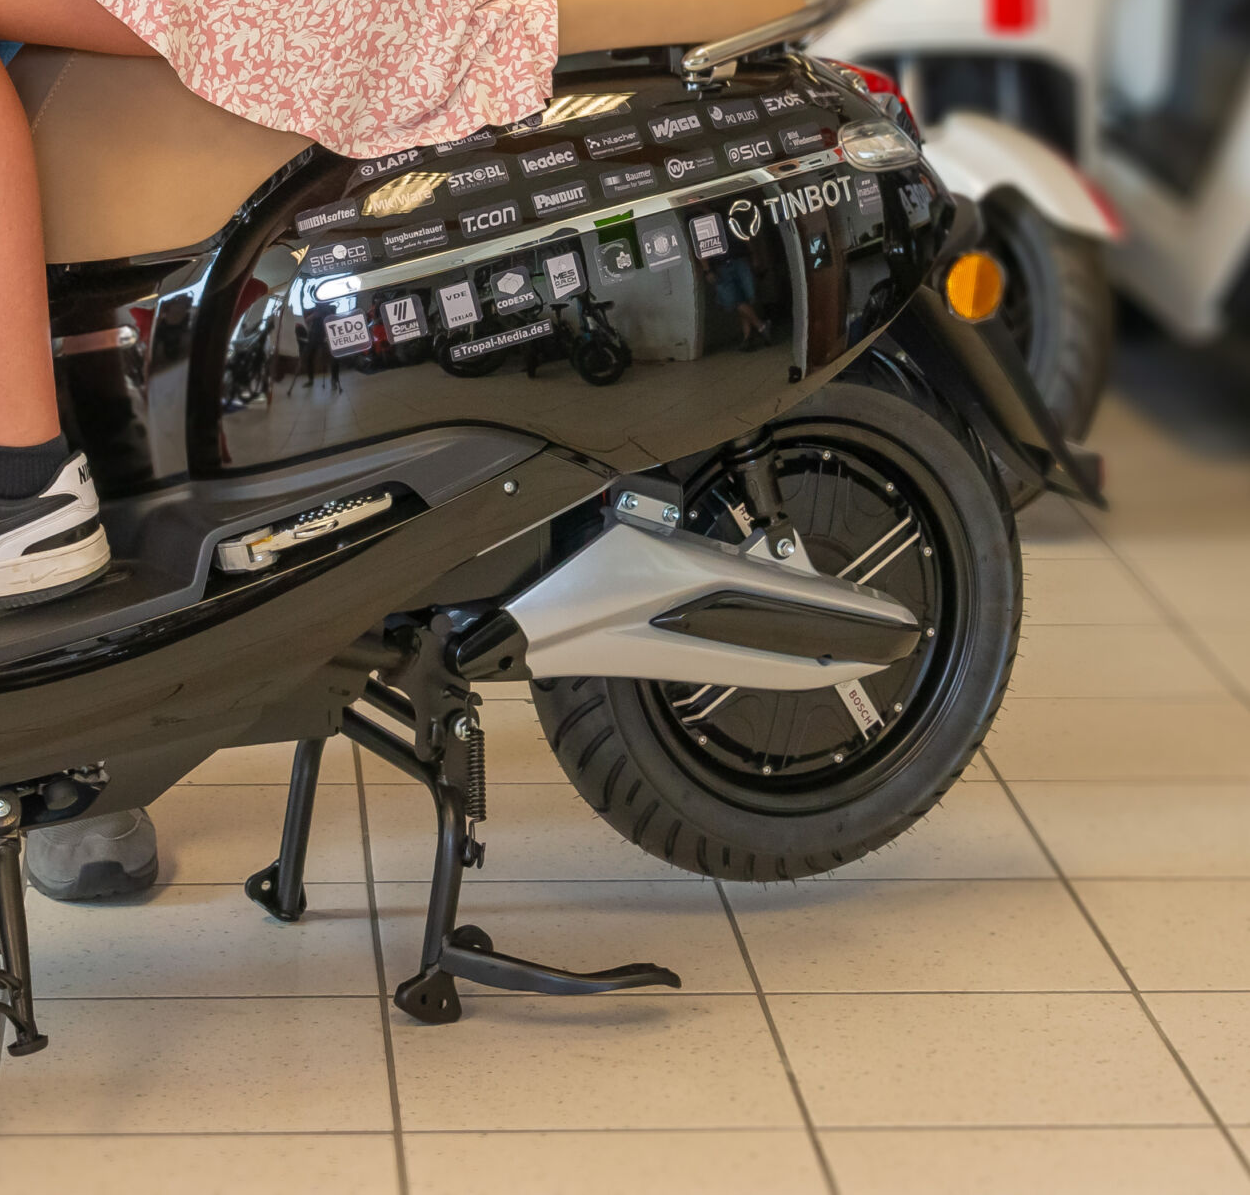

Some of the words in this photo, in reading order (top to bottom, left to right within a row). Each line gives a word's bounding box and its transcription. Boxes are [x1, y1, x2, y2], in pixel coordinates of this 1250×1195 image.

[652, 115, 701, 139] WAGO
[376, 149, 419, 172] LAPP
[522, 150, 574, 173] leadec
[763, 175, 851, 225] TINBOT
[385, 224, 443, 245] Jungbunzlauer
[445, 290, 467, 302] VDE
[496, 291, 534, 309] CODESYS
[332, 332, 366, 347] VERLAG
[461, 324, 543, 356] Tropal-Media.de
[848, 689, 874, 726] BOSCH
